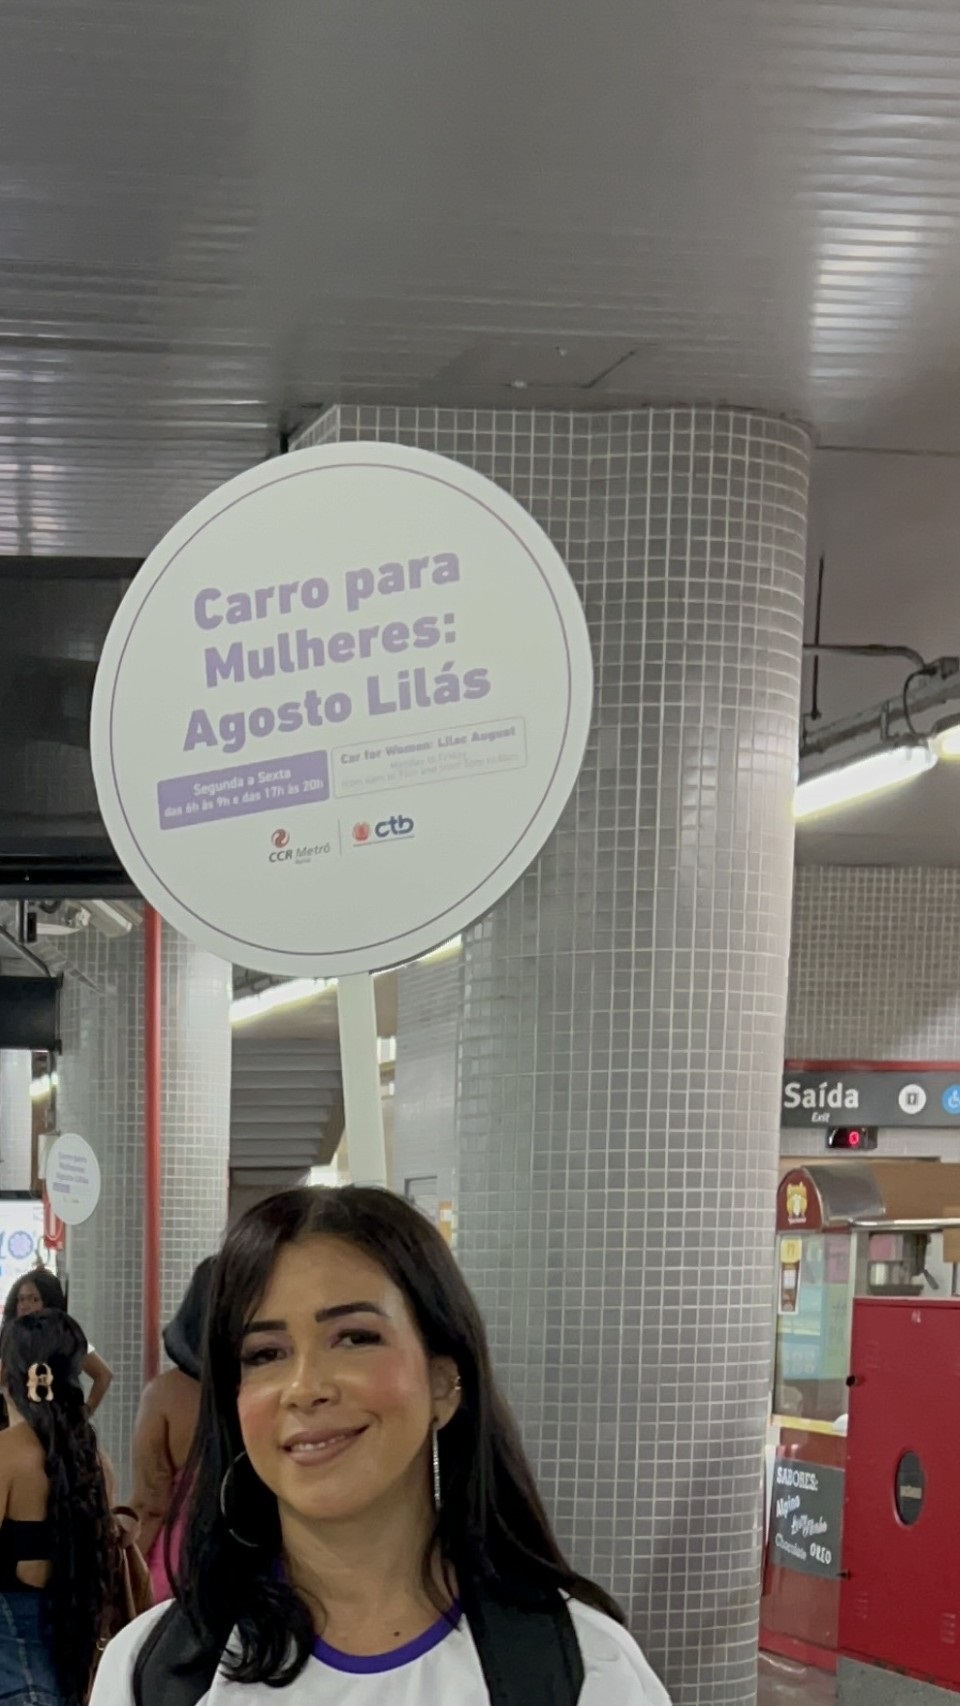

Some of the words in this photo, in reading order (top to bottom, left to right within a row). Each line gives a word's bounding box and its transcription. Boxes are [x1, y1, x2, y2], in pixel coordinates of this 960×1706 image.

[194, 577, 330, 631] Carro
[345, 551, 462, 612] para
[204, 612, 457, 688] Mulheres:
[183, 690, 353, 753] Agosto
[366, 661, 493, 716] Lilás
[340, 752, 361, 765] Car
[364, 748, 381, 760] for
[437, 735, 468, 748] Lilac
[471, 726, 517, 743] August
[193, 776, 245, 797] Segunda
[247, 776, 255, 787] a
[258, 769, 292, 784] Sexta
[164, 805, 183, 818] das
[242, 790, 261, 804] das
[264, 785, 285, 800] 17h
[302, 778, 325, 793] 20h
[374, 814, 415, 838] ctb
[268, 850, 293, 863] CCR
[295, 843, 331, 859] Metrô
[783, 1081, 859, 1109] Saída
[811, 1112, 831, 1123] Exit
[809, 1542, 832, 1565] OREO
